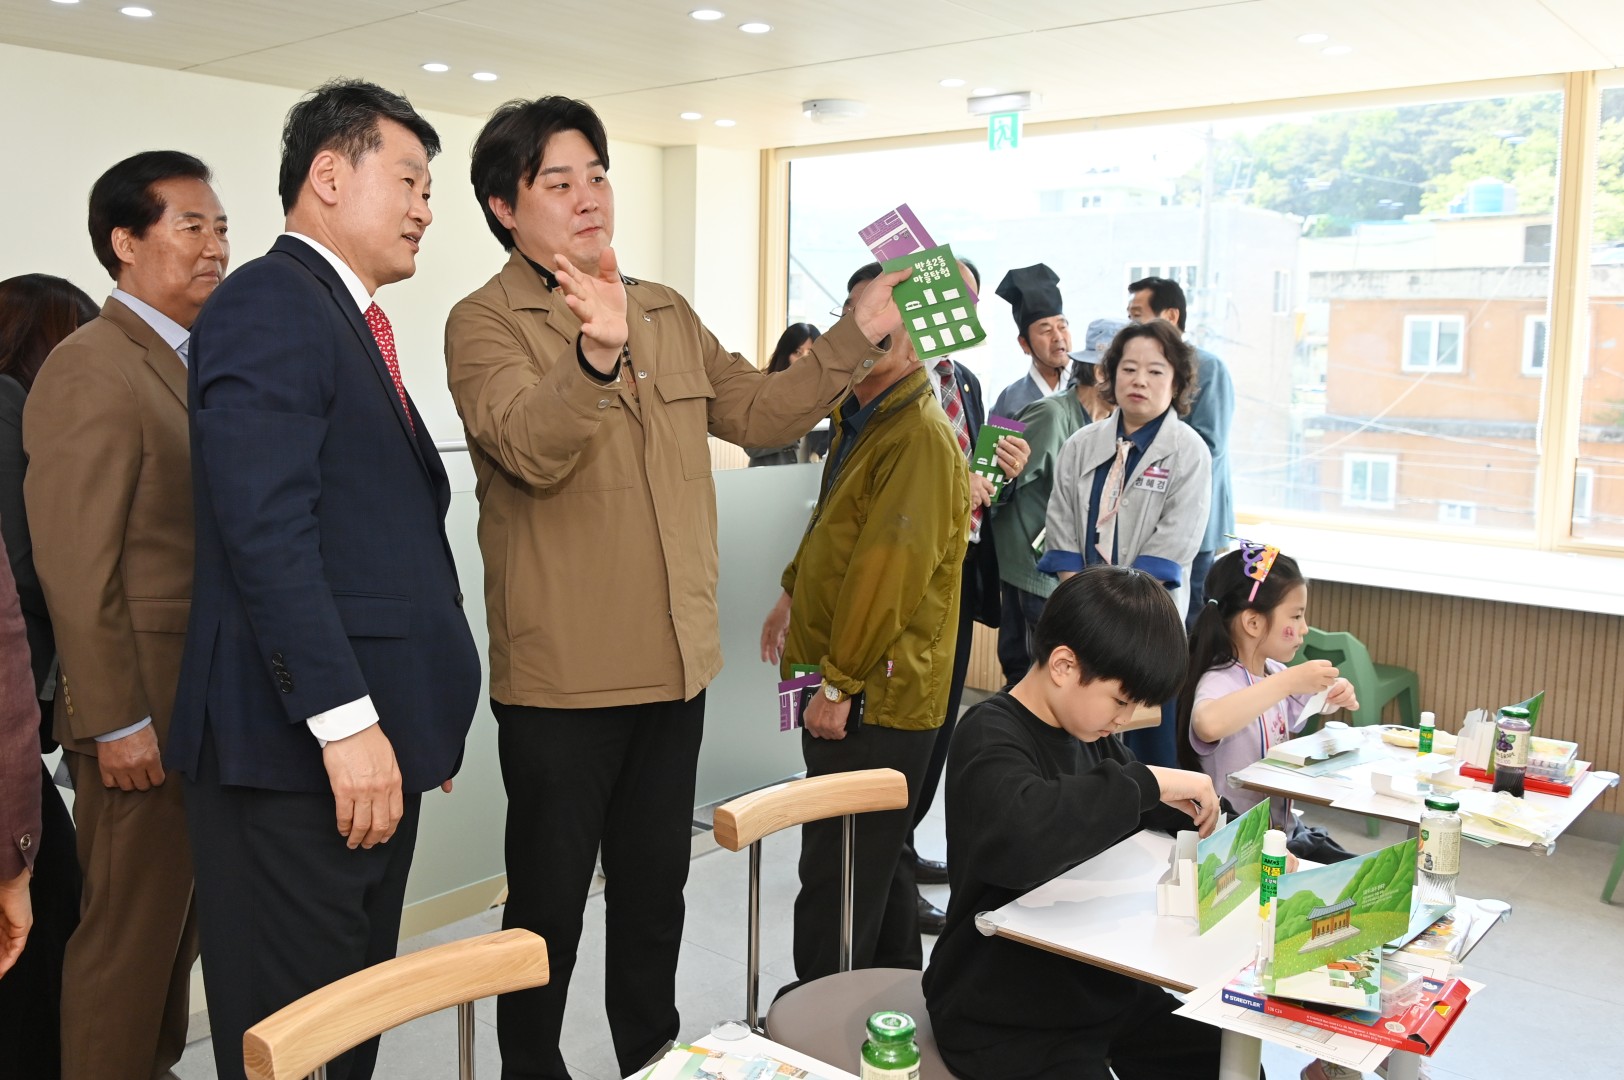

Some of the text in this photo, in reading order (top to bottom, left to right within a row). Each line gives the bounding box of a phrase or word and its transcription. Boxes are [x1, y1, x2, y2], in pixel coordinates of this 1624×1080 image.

[914, 255, 946, 272] 반송2동
[913, 267, 950, 284] 마을탐험
[1229, 995, 1261, 1008] STAEDTLER
